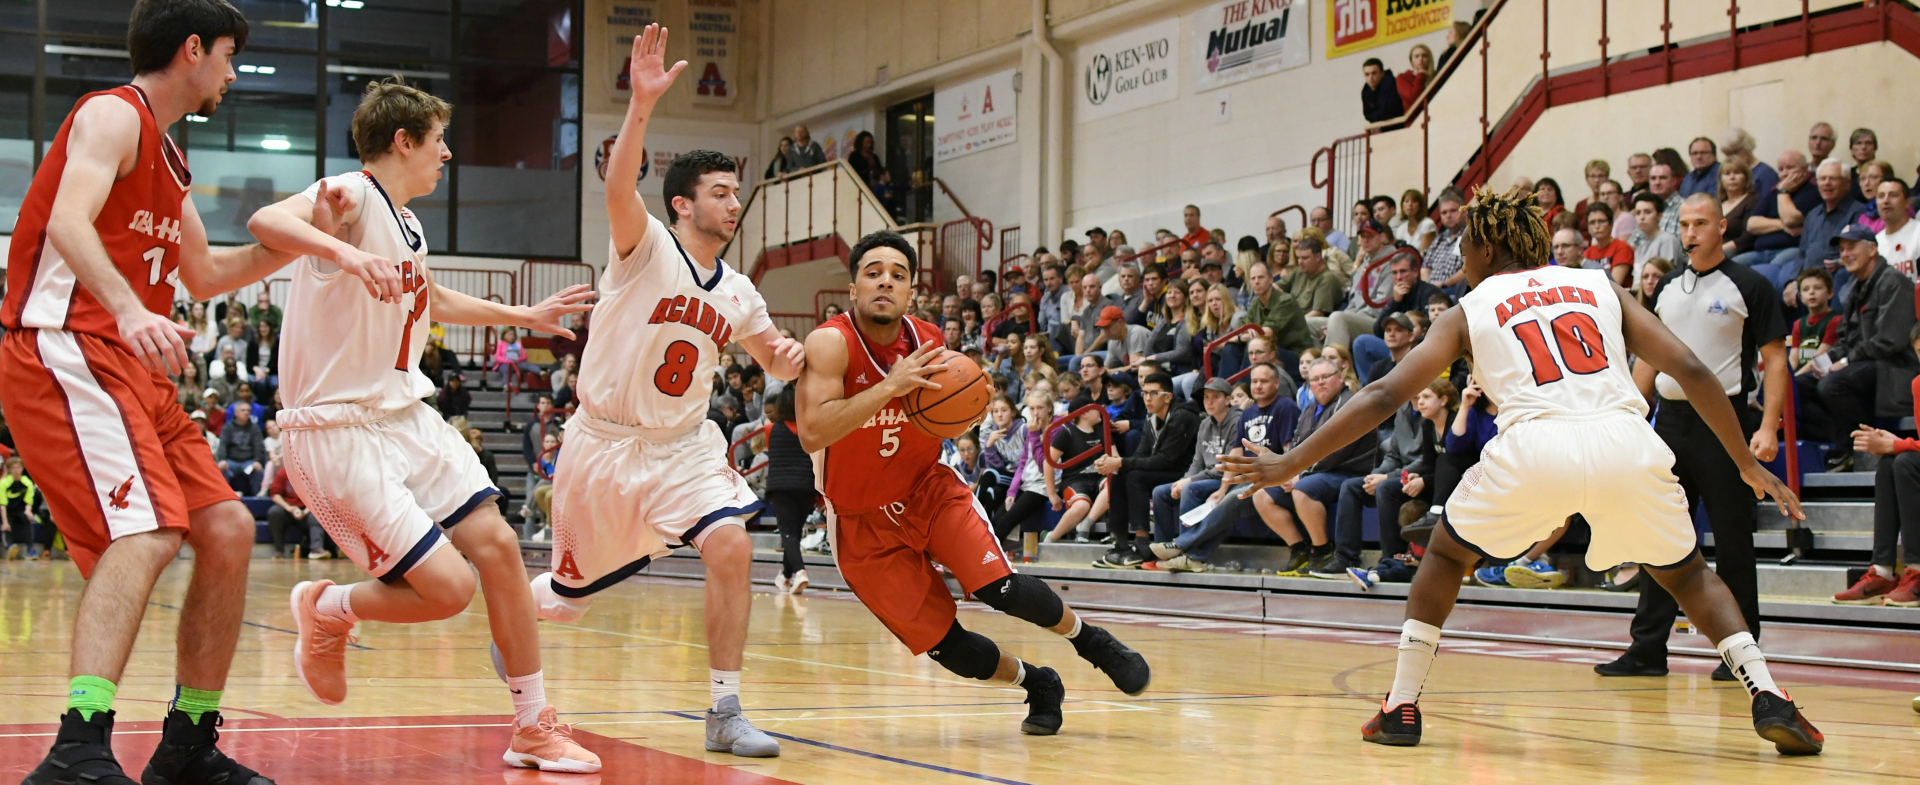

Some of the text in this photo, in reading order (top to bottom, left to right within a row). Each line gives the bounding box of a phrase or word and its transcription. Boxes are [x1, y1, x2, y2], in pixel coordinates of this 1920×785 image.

[1223, 1, 1249, 26] THE
[1386, 5, 1450, 36] hardware
[1206, 8, 1290, 60] Mutual
[1115, 38, 1169, 72] KEN-WO
[982, 85, 994, 114] A
[1221, 101, 1227, 115] 7
[1528, 277, 1544, 288] A
[1494, 285, 1598, 328] AXEMEN
[1511, 310, 1610, 387] 10
[653, 339, 699, 397] 8
[878, 426, 902, 458] 5
[361, 532, 390, 571] A
[556, 550, 584, 580] A
